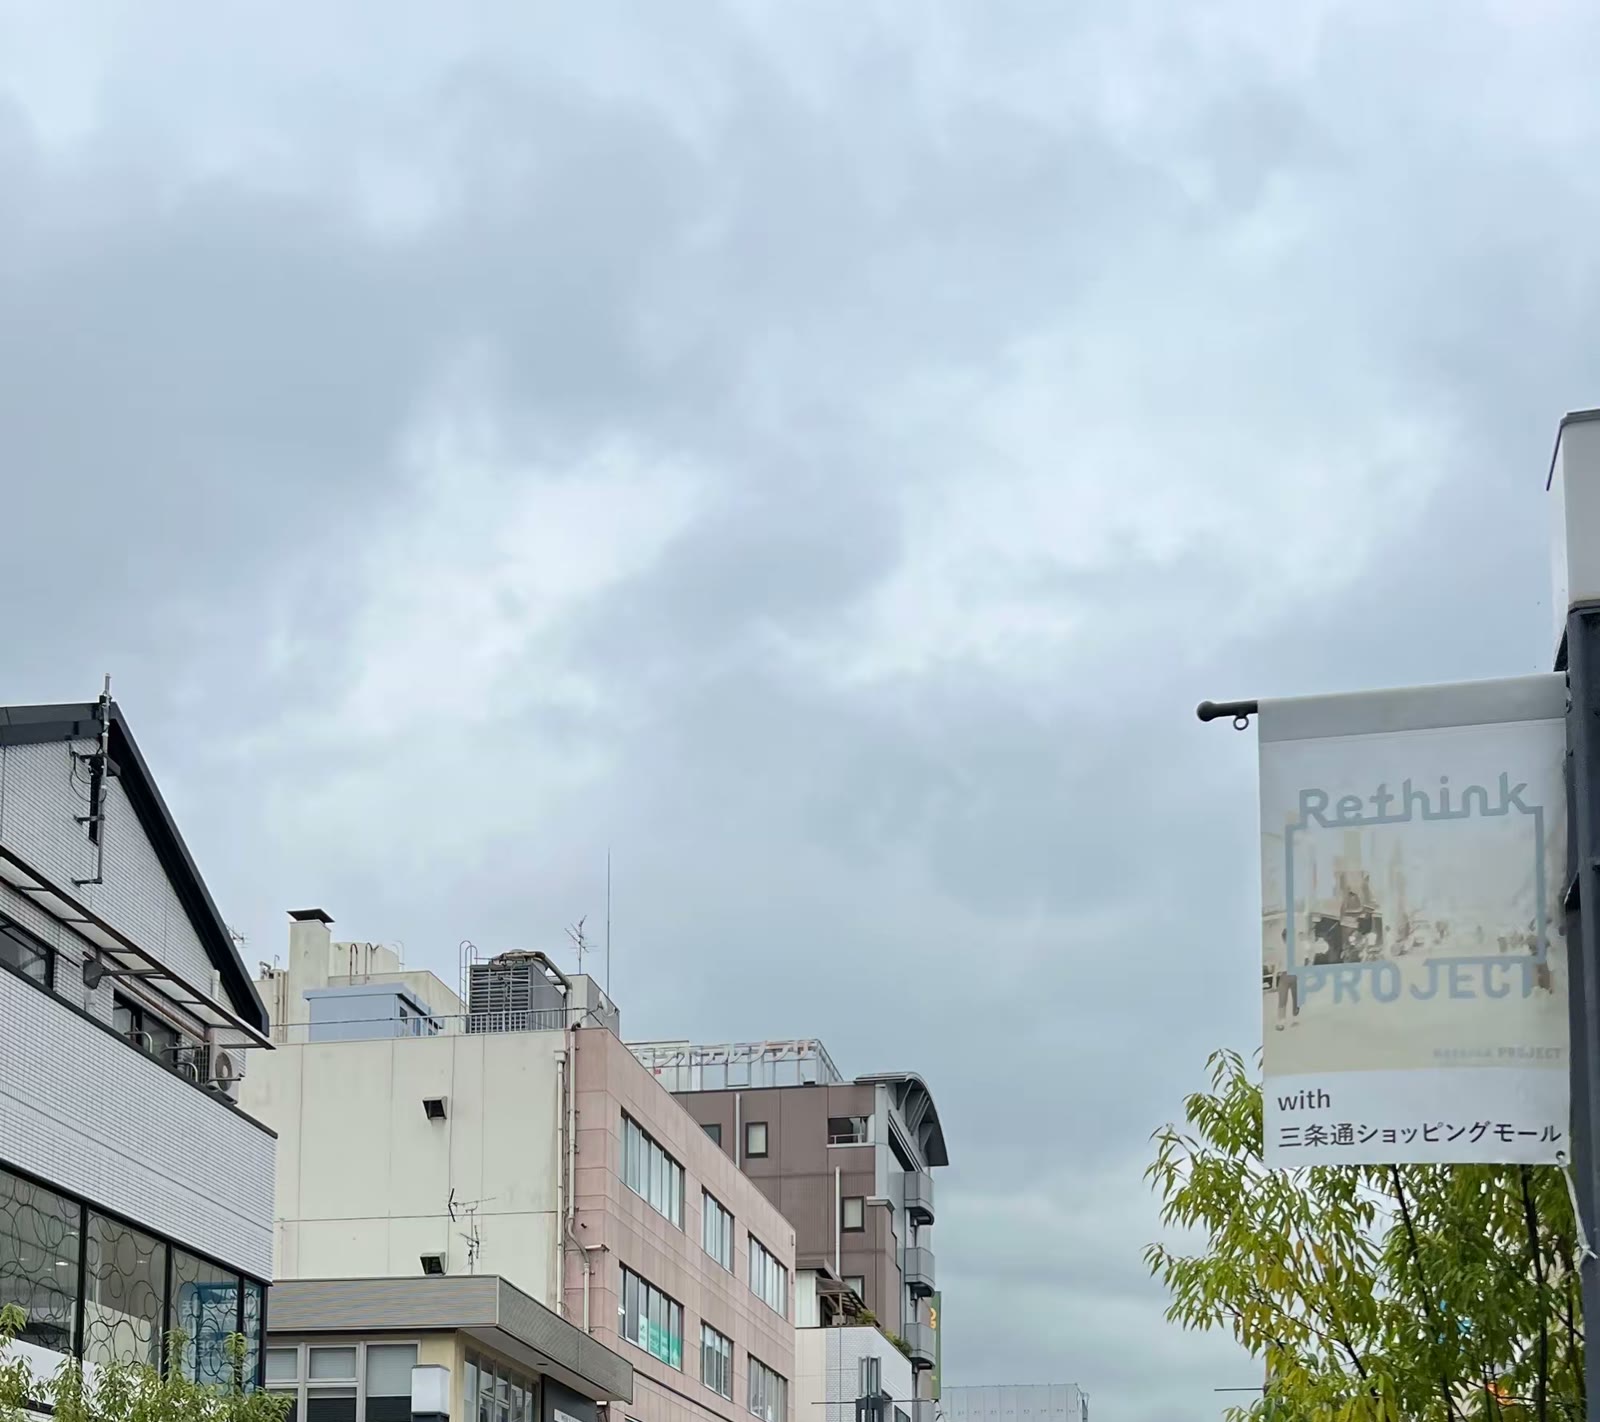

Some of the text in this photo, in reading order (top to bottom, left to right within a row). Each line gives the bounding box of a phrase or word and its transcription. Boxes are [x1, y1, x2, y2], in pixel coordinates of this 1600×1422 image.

[1298, 771, 1532, 829] Rethink
[1297, 956, 1538, 1008] PROJECT
[1277, 1088, 1331, 1111] with
[1278, 1120, 1563, 1148] 三条通ショッピングモール
